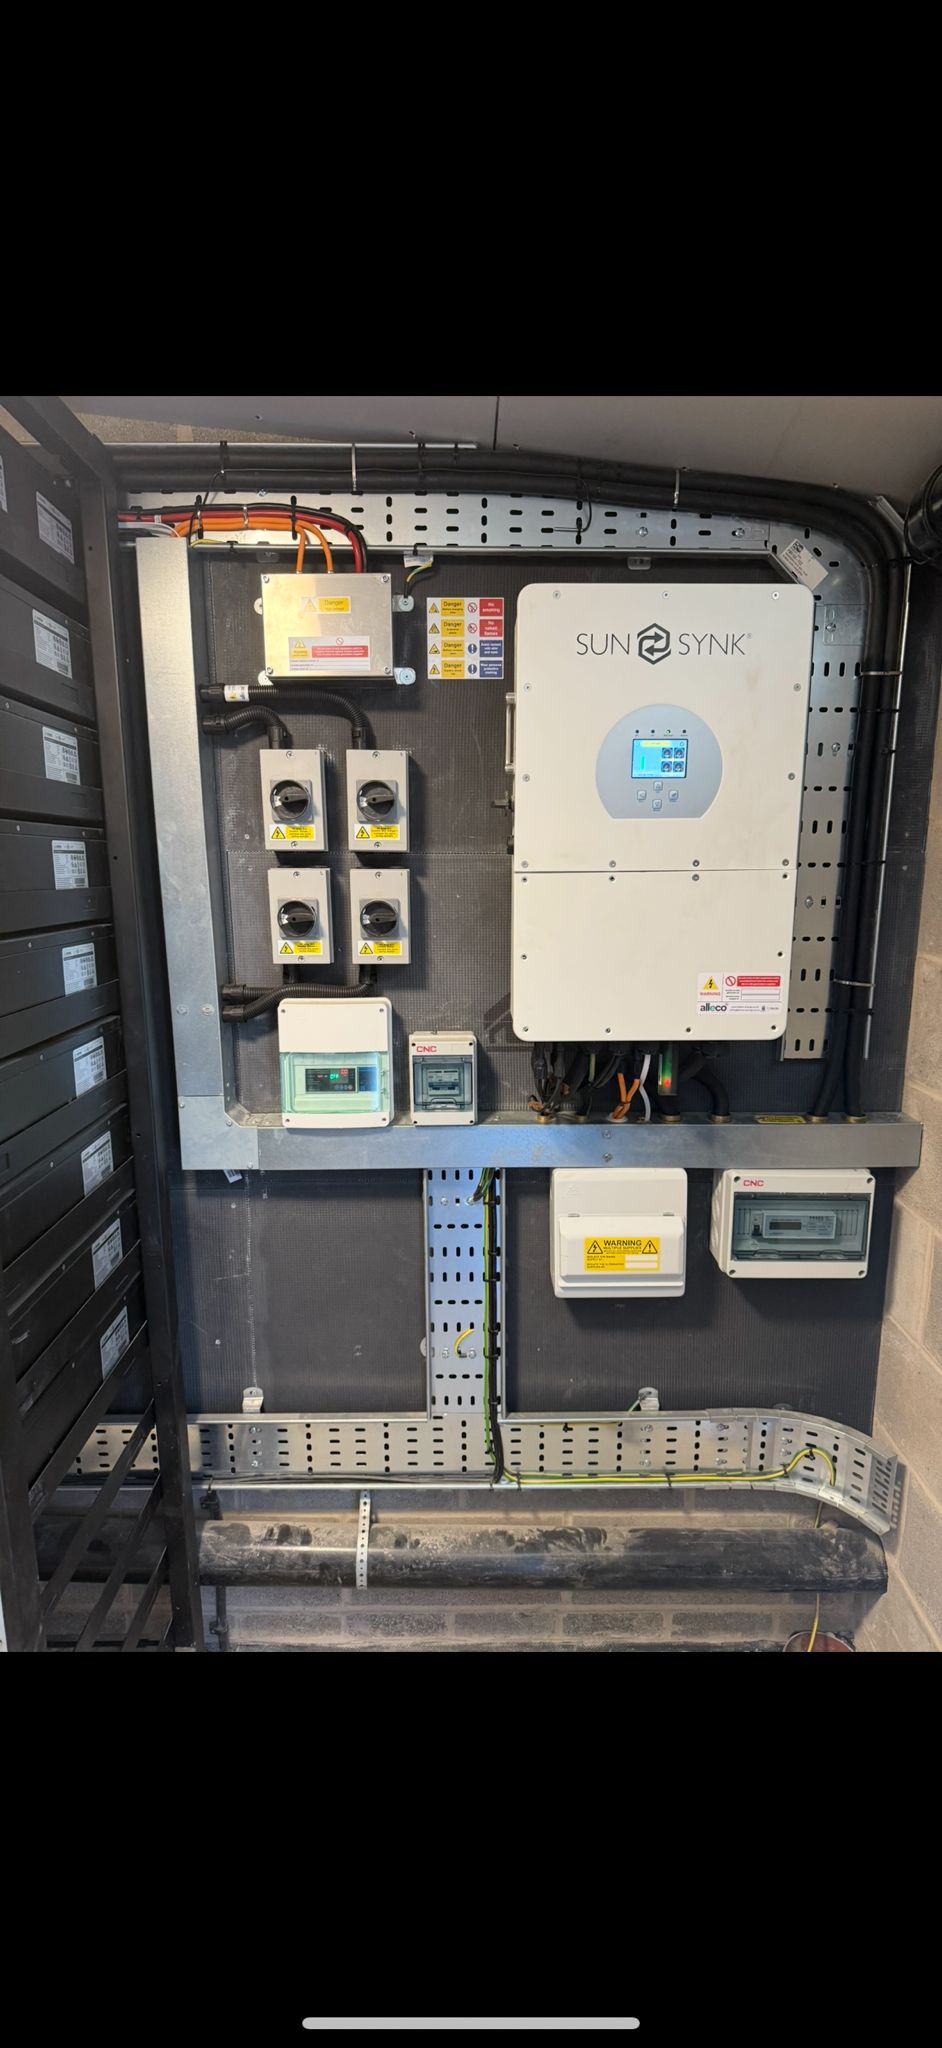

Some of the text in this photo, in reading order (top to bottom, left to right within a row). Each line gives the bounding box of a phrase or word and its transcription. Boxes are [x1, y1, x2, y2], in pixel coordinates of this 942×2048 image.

[576, 633, 746, 656] SUN SYNK
[700, 1002, 727, 1012] alleco
[416, 1045, 437, 1053] CNC
[743, 1179, 764, 1187] CNC
[603, 1239, 642, 1247] WARNING
